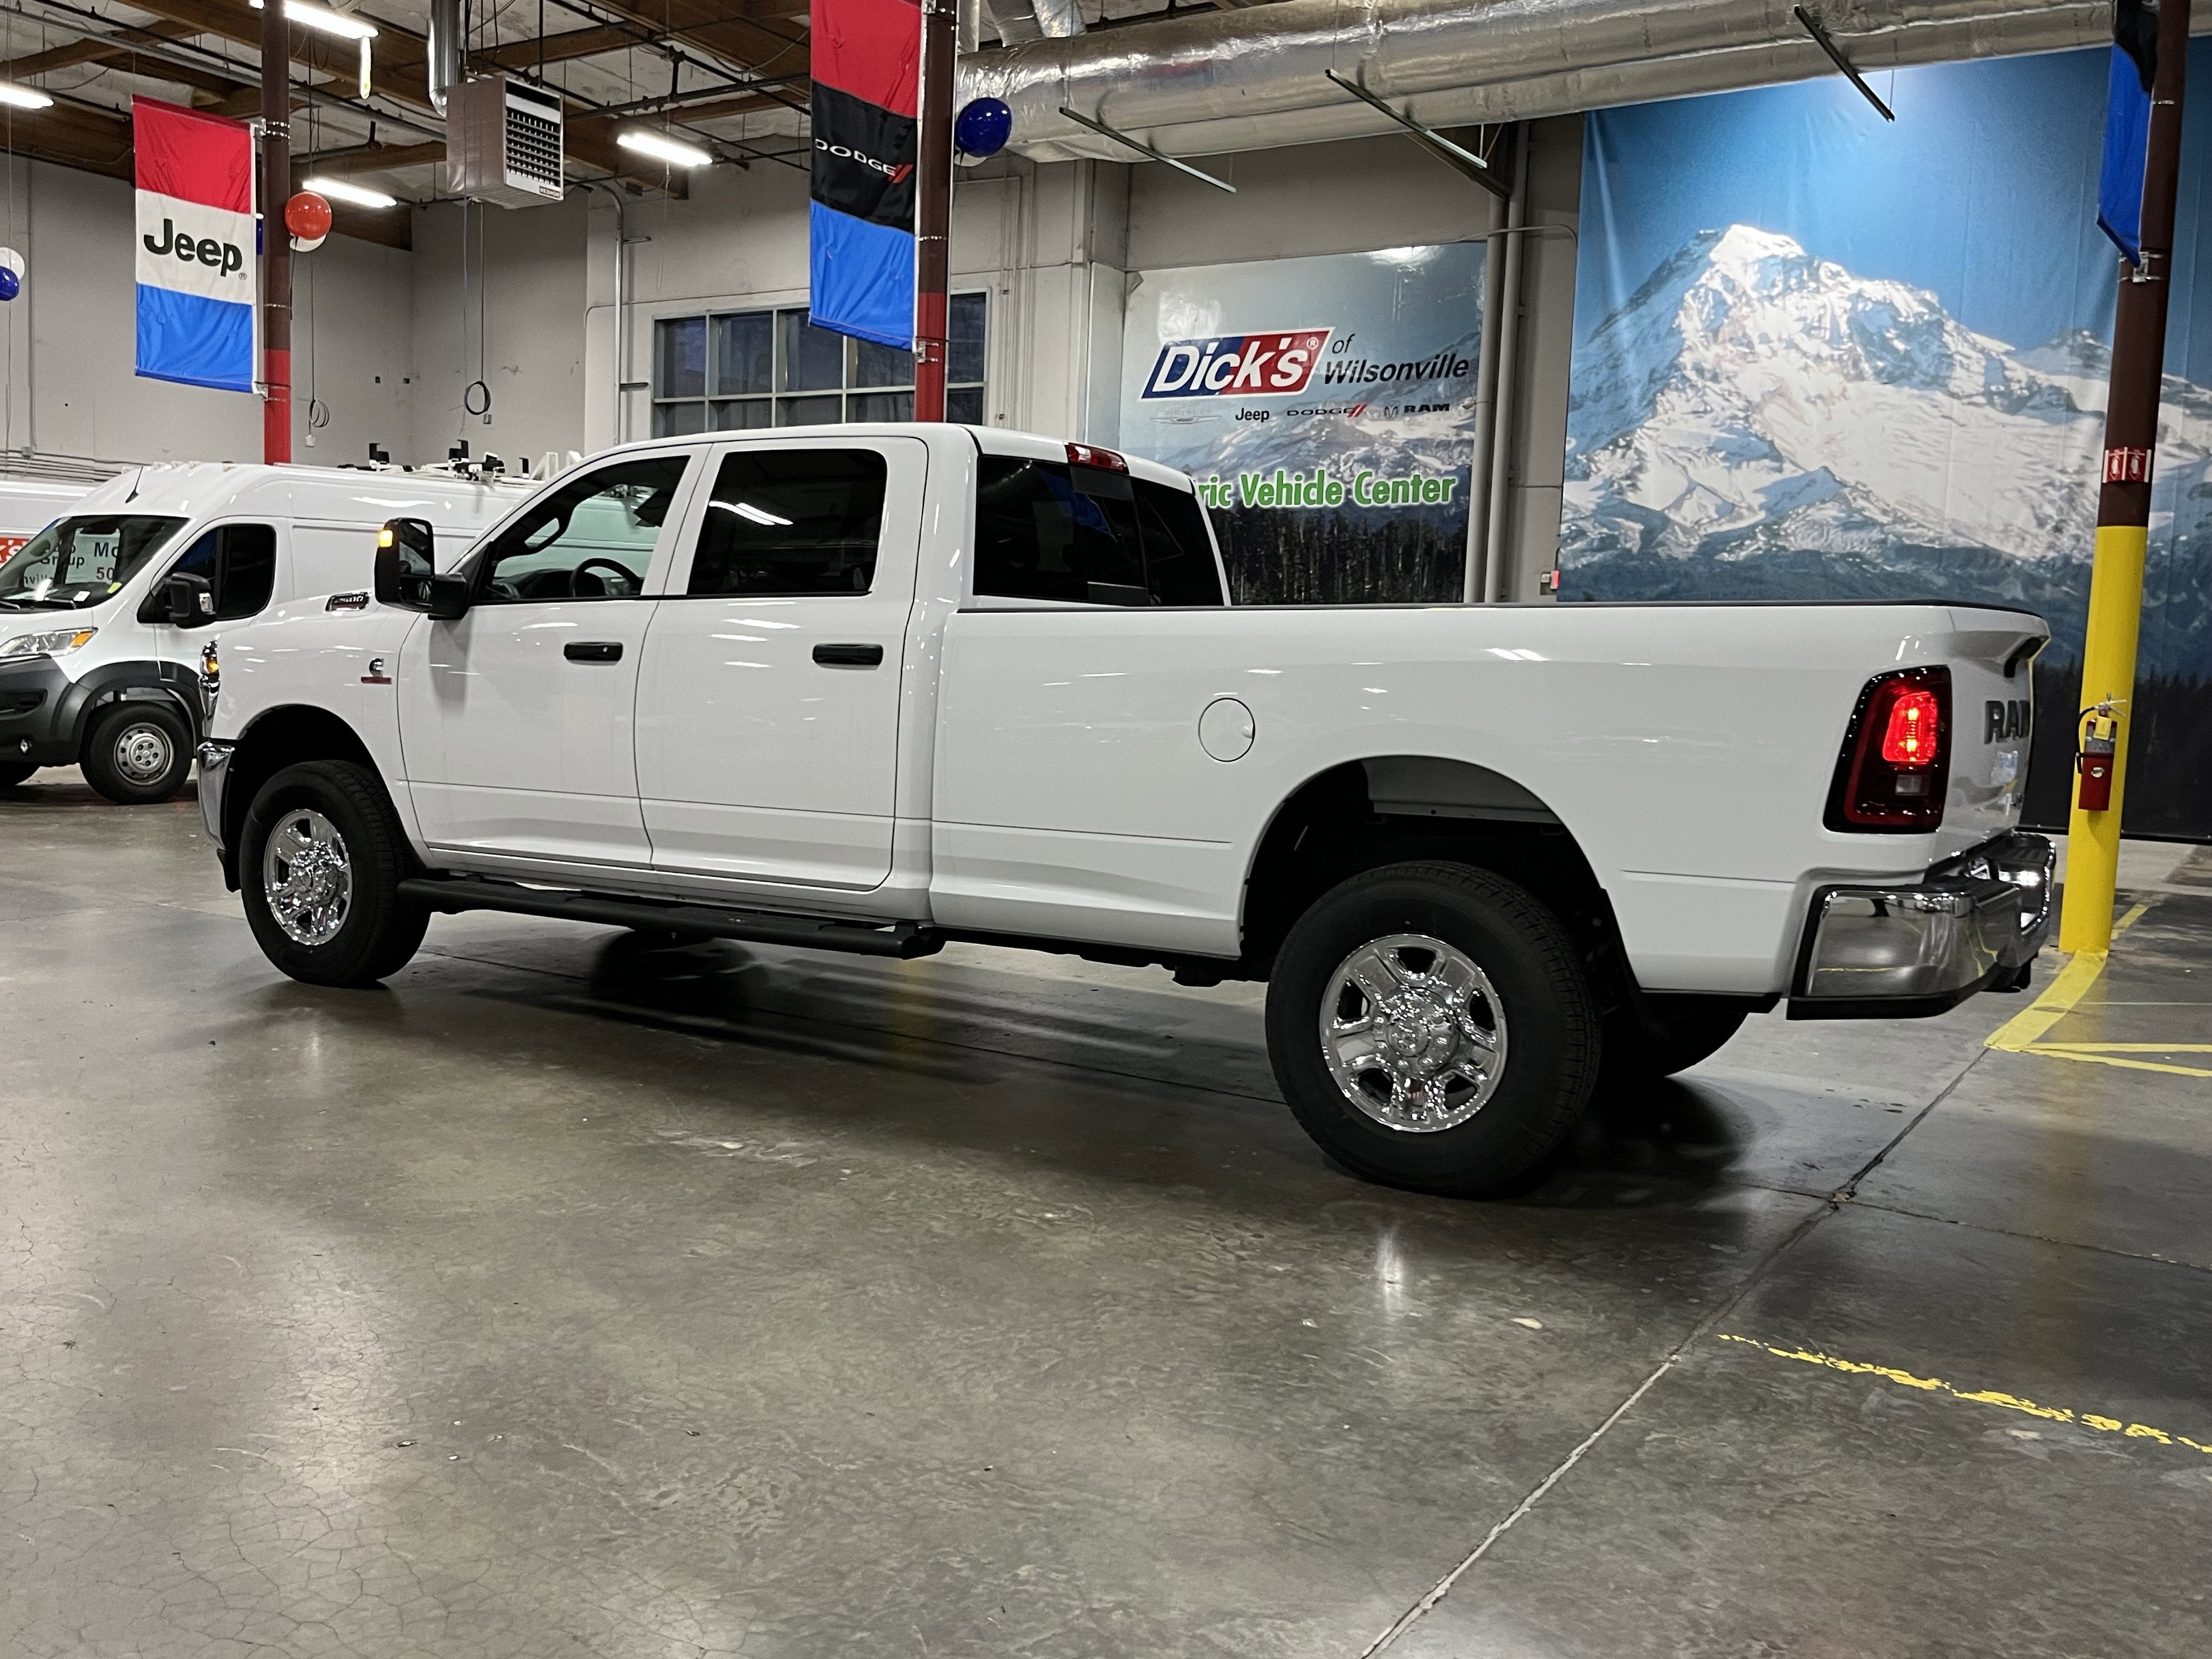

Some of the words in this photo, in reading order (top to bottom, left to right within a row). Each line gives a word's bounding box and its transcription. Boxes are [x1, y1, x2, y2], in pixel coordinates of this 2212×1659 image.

[815, 138, 896, 176] DODGE
[144, 218, 242, 277] Jeep
[1332, 334, 1356, 354] of
[1152, 337, 1308, 392] Dick's
[1325, 354, 1469, 384] Wilsonville
[1235, 408, 1269, 422] Jeep
[1287, 408, 1355, 416] DODGE
[1404, 403, 1449, 413] RAM
[1241, 470, 1342, 505] Vehicle
[1355, 471, 1455, 505] Center
[96, 567, 114, 580] 50
